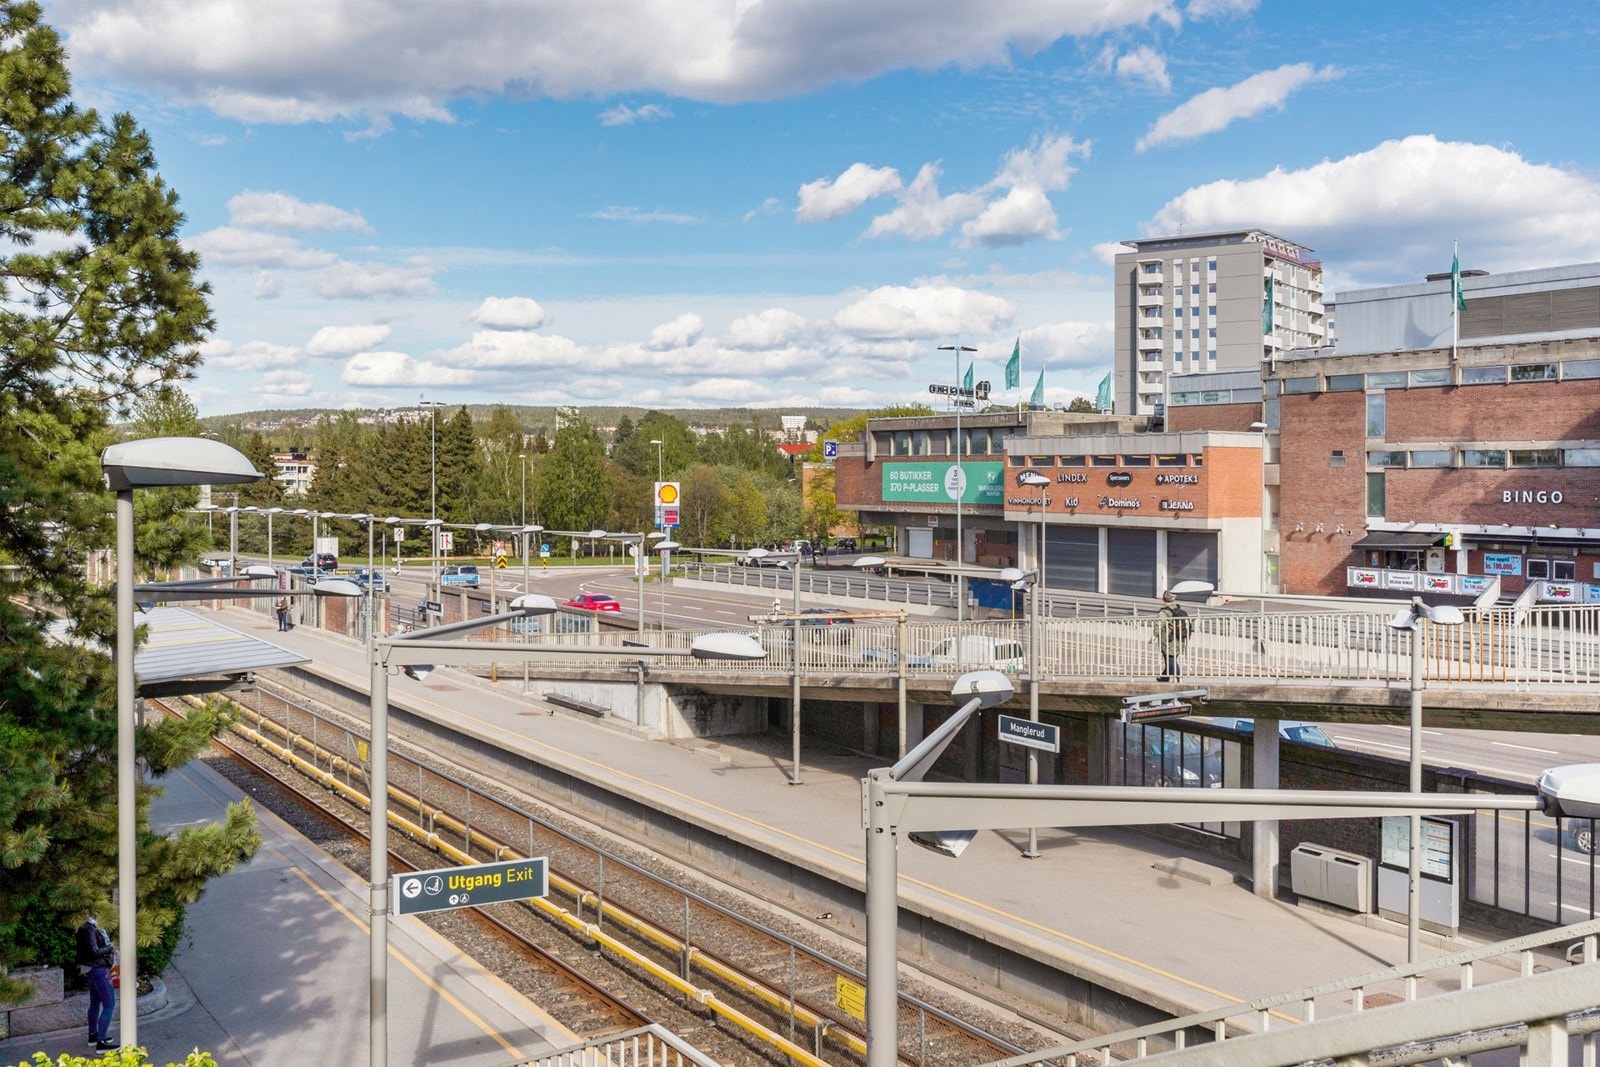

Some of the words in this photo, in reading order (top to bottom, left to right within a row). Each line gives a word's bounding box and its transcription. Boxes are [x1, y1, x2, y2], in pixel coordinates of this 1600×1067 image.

[889, 471, 898, 480] 60
[899, 470, 932, 480] BUTIKKER
[1057, 473, 1087, 482] LINDEX
[1164, 474, 1192, 483] APOTEK
[889, 482, 902, 492] 370
[903, 482, 939, 493] P-PLASSER
[1502, 490, 1563, 504] BINGO
[1108, 498, 1141, 508] Domino's
[1010, 722, 1045, 738] Manglerud
[448, 872, 502, 891] Utgang
[506, 867, 533, 883] Exit
